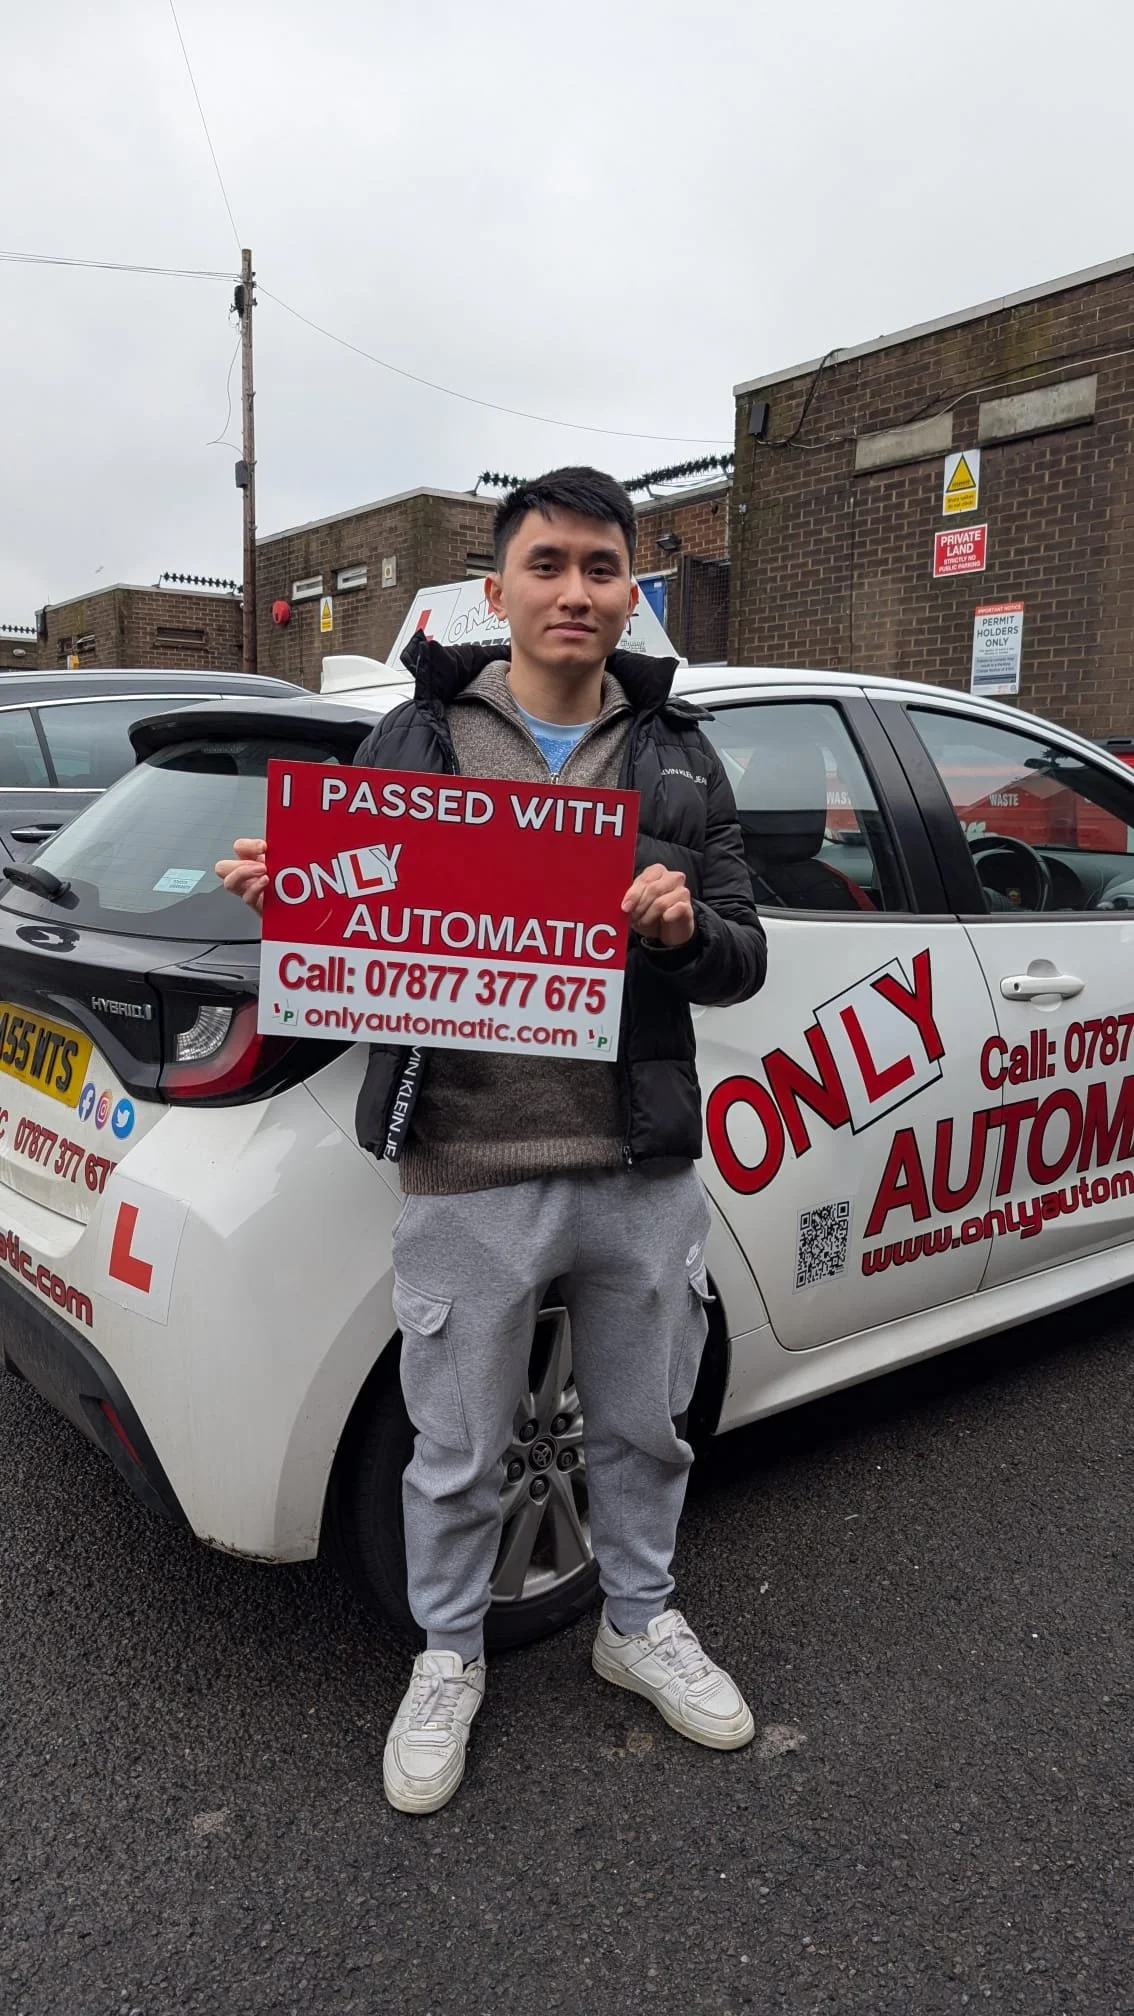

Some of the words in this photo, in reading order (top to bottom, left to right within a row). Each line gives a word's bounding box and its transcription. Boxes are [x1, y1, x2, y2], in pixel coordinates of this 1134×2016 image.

[941, 530, 982, 547] PRIVATE
[947, 543, 974, 557] LAND
[977, 626, 1019, 638] HOLDERS
[982, 616, 1015, 626] PERMIT
[985, 637, 1009, 648] ONLY
[281, 773, 293, 808] I
[321, 776, 495, 825] PASSED
[509, 793, 626, 838] WITH
[990, 793, 1020, 808] WASTE
[274, 843, 403, 905] ONLY
[342, 902, 617, 962] AUTOMATIC
[91, 996, 146, 1019] HYBRID
[278, 951, 357, 995] Call:
[364, 959, 469, 1004] 07877
[475, 967, 538, 1009] 377
[544, 974, 607, 1015] 675
[304, 1005, 578, 1048] onlyautomatic.com
[980, 1035, 1057, 1091] Call:
[1064, 1012, 1134, 1074] 0787
[706, 947, 946, 1197] ONLY
[389, 1079, 415, 1133] KLEIN
[14, 1117, 59, 1167] 07877
[54, 1138, 85, 1183] 377
[863, 1074, 1134, 1240] AUTOM
[108, 1201, 153, 1293] L
[861, 1169, 1134, 1277] www.onlyautom
